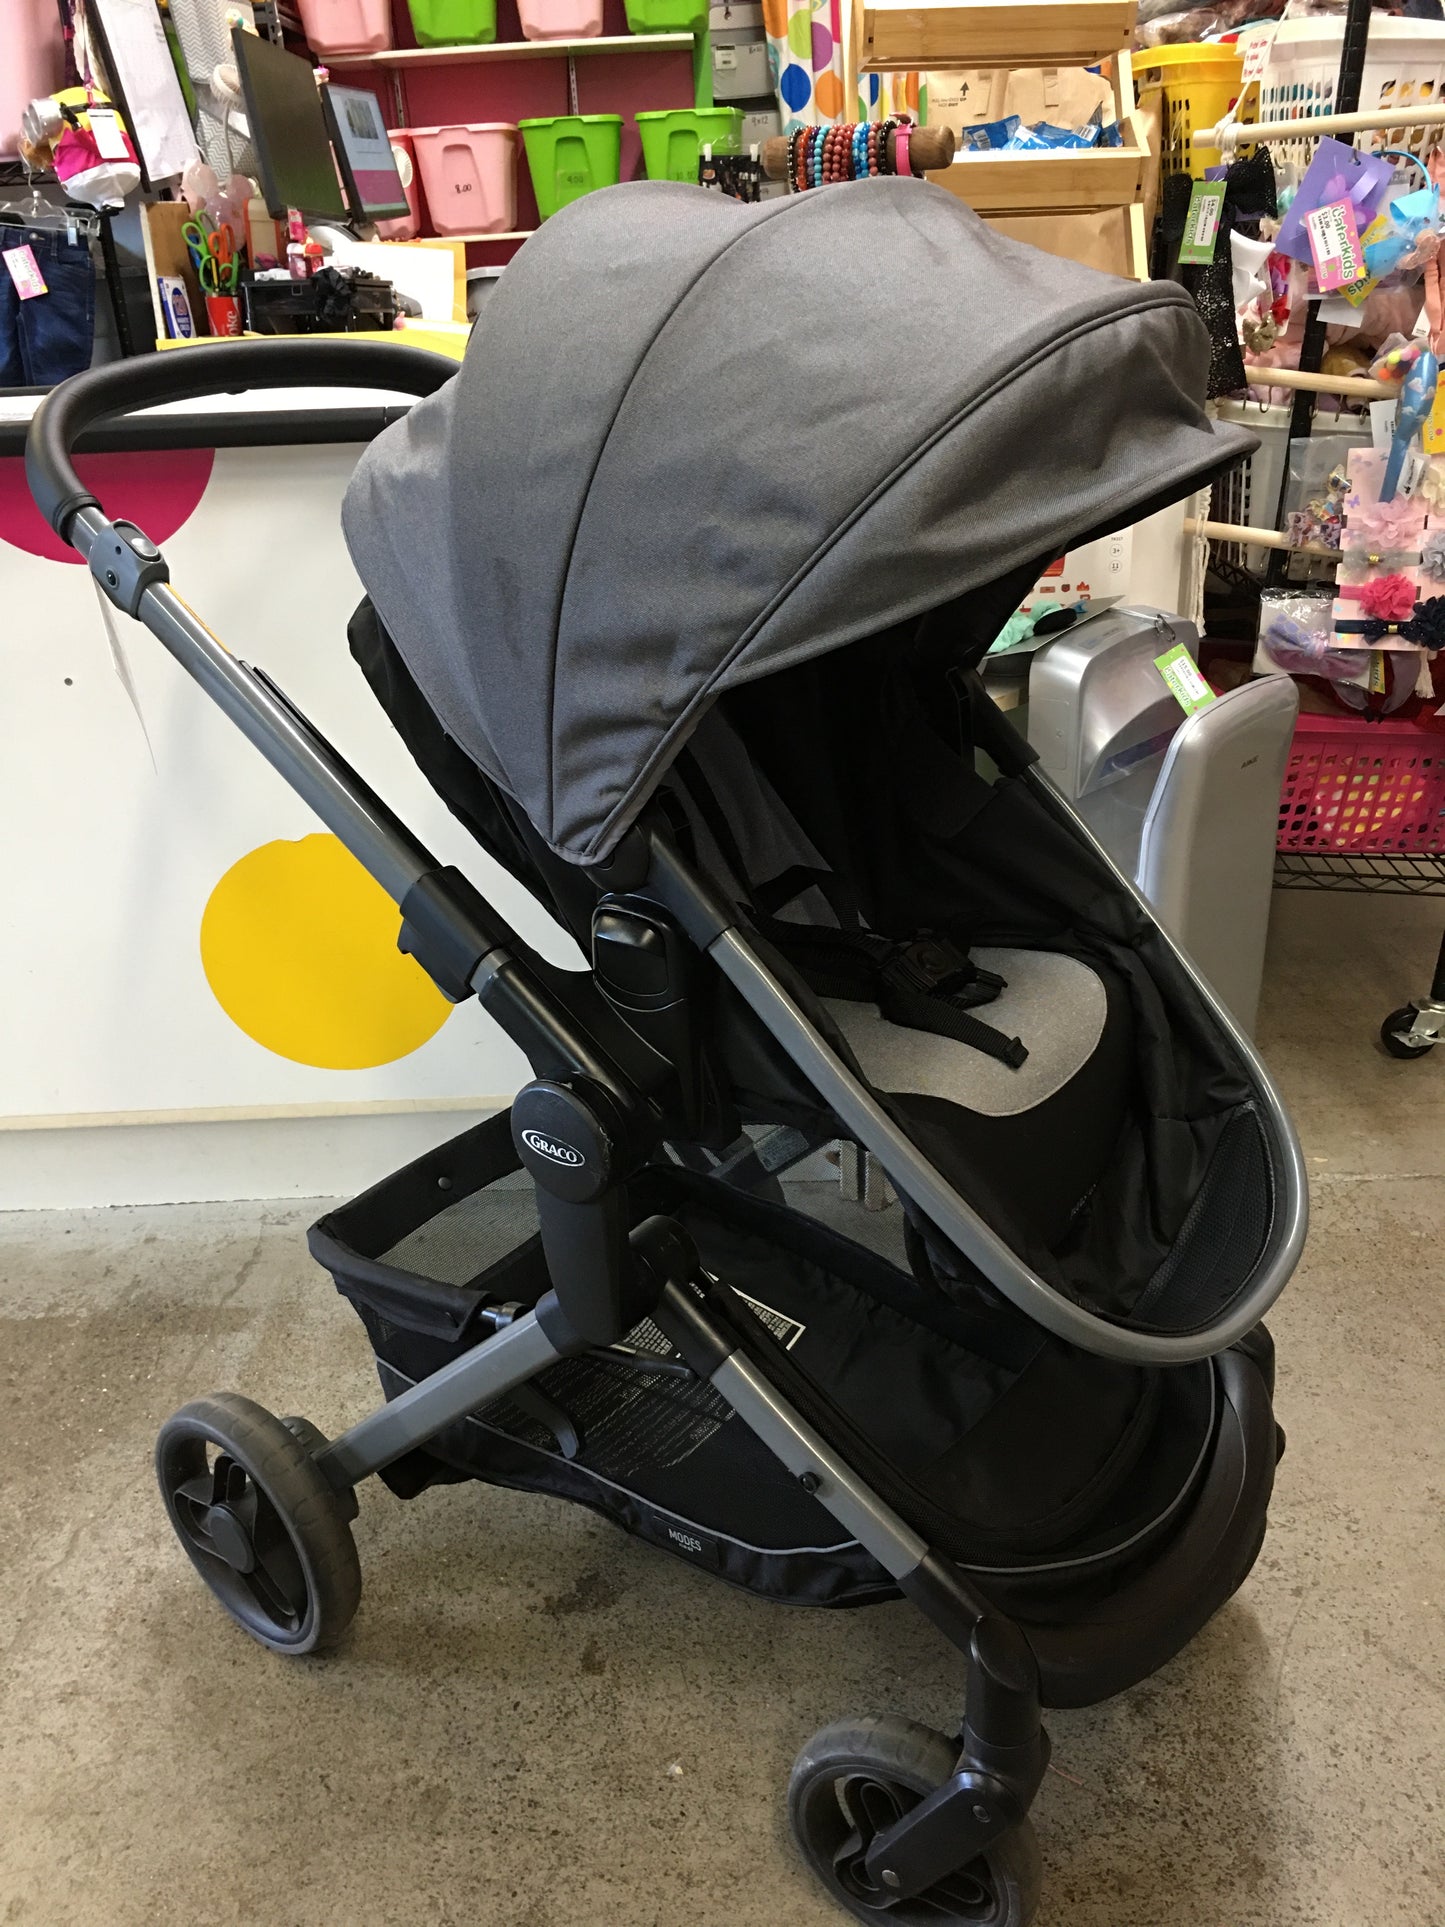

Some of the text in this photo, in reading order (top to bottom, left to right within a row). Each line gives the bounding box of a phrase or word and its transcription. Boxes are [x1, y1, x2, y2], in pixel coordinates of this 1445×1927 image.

[1331, 204, 1356, 280] Caterkids
[530, 1134, 577, 1163] GRACO
[668, 1528, 702, 1551] MODES
